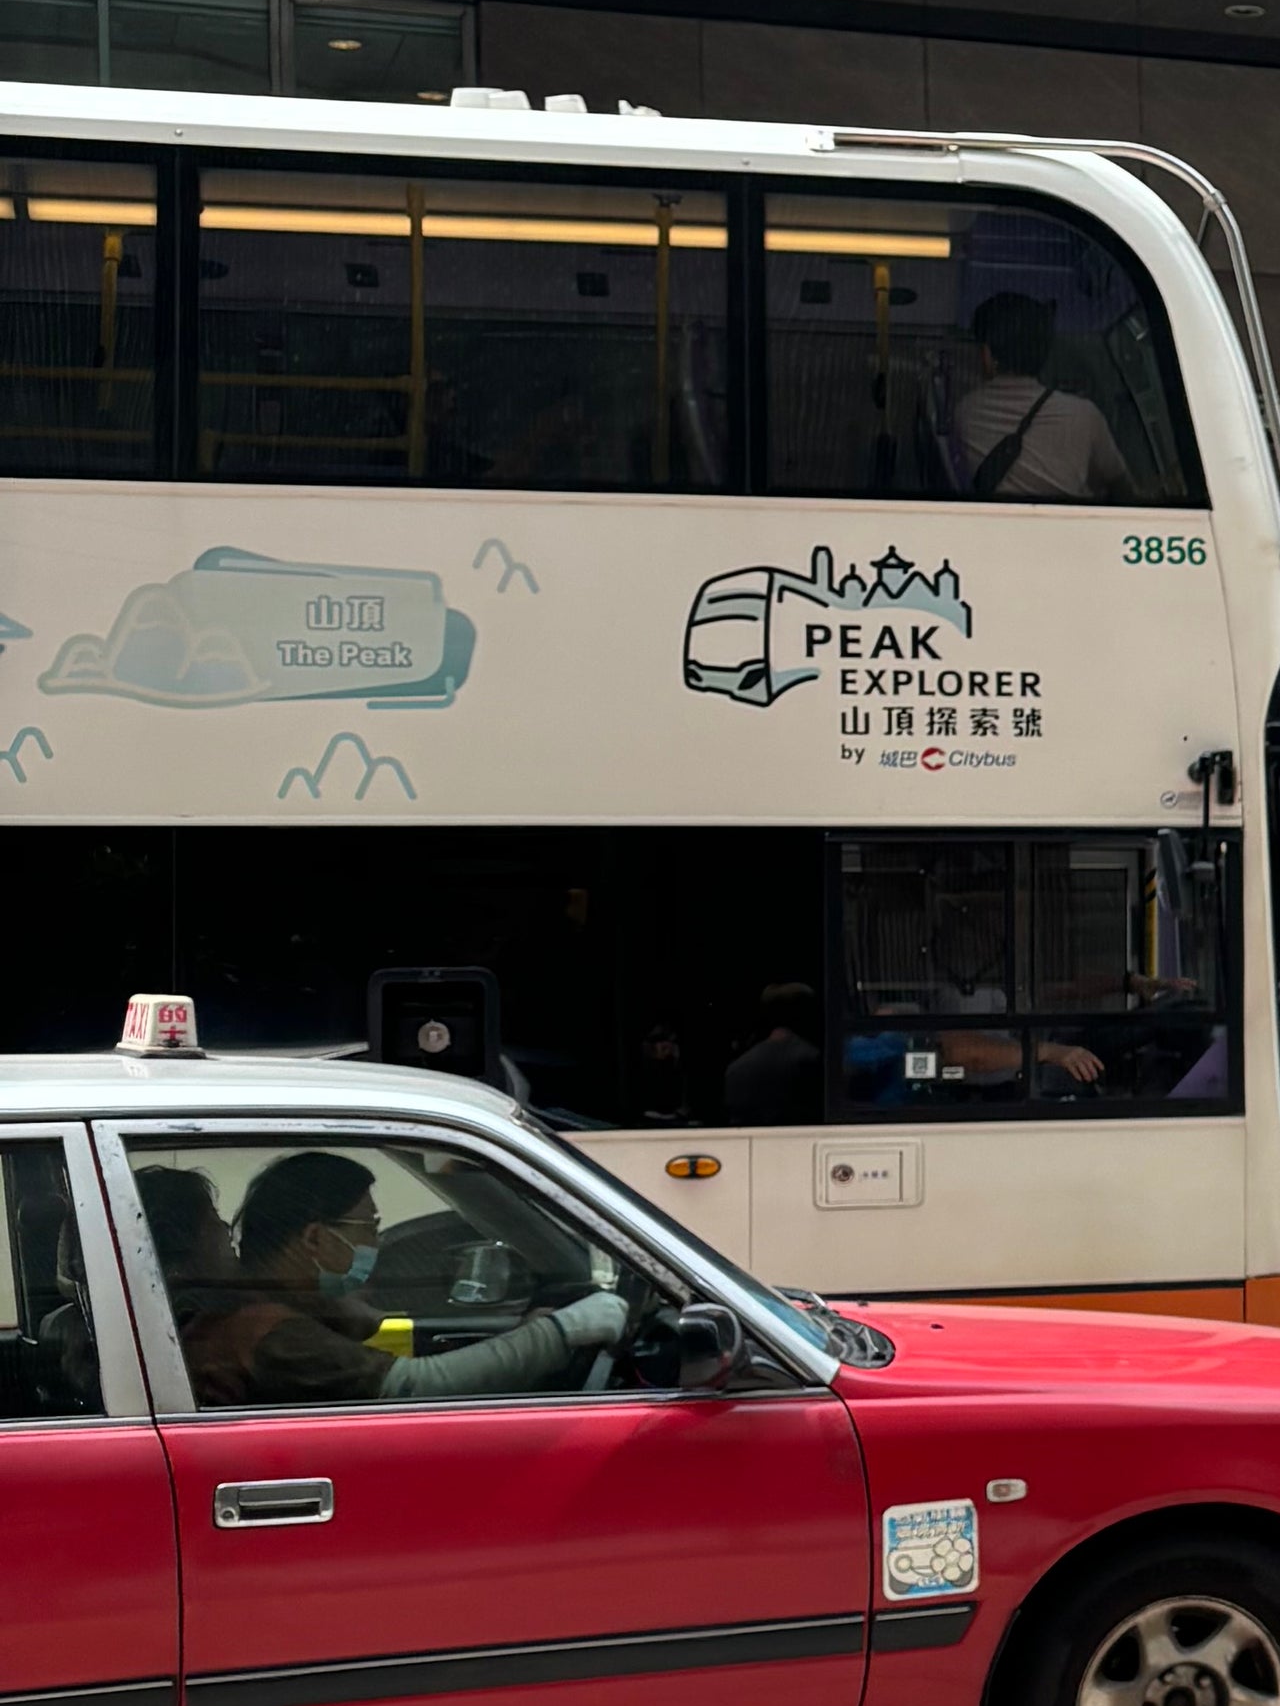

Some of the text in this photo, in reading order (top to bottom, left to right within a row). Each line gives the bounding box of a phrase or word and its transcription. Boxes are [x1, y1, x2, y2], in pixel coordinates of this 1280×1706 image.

[1122, 534, 1207, 566] 3856
[306, 594, 385, 632] 山頂
[277, 640, 413, 668] The Peak
[804, 624, 942, 660] PEAK
[840, 668, 1043, 698] EXPLORER
[840, 705, 1043, 738] 山頂探索號
[840, 743, 1017, 769] by 城巴 Citybus
